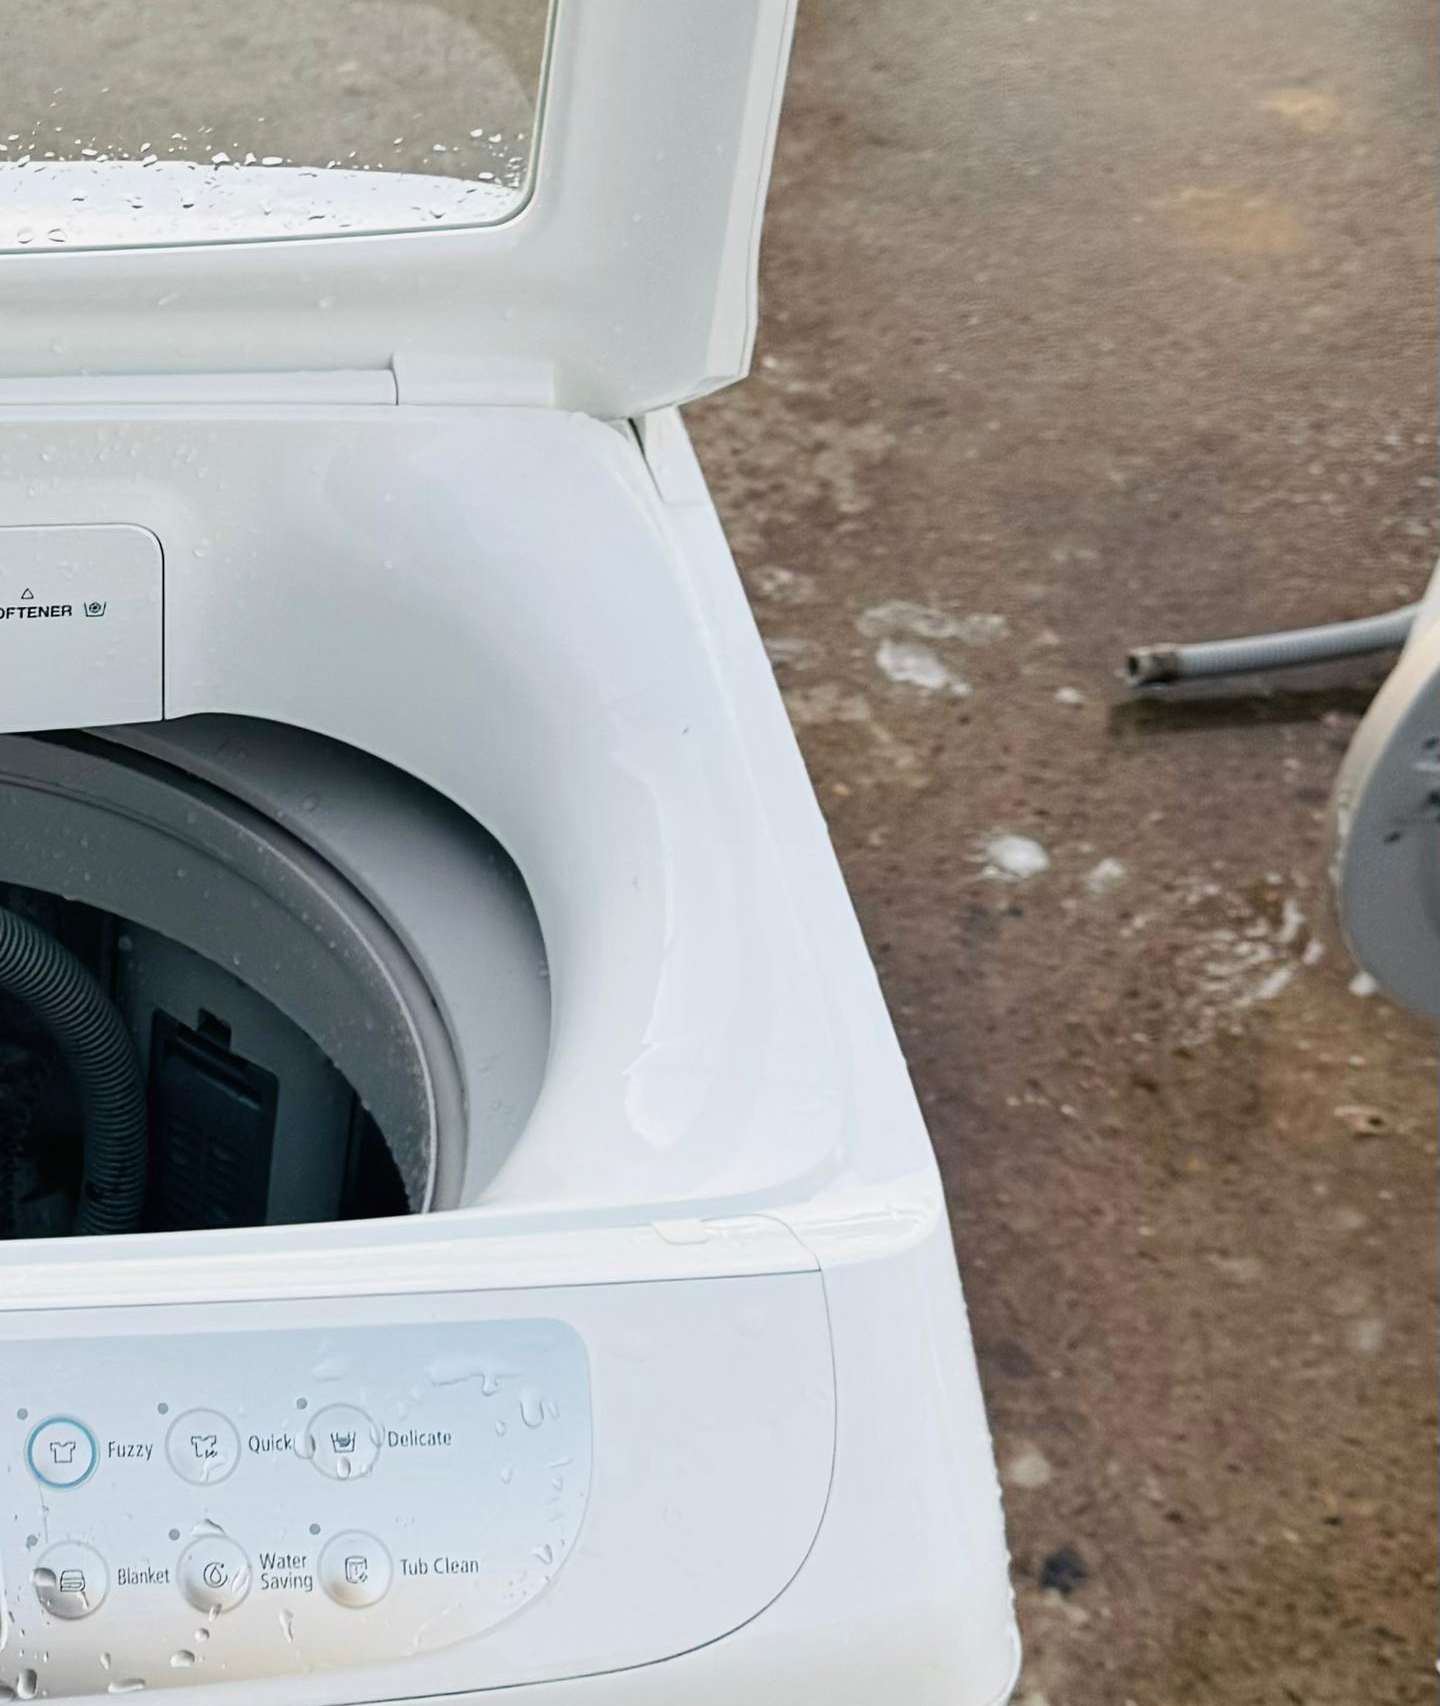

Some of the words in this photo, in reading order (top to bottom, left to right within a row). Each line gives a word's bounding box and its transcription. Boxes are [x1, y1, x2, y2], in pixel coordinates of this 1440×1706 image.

[248, 1434, 293, 1452] Quick
[387, 1429, 453, 1447] Delicate
[108, 1441, 154, 1461] Fuzzy
[260, 1553, 308, 1570] Water
[400, 1558, 428, 1575] Tub
[433, 1557, 480, 1574] Clean
[117, 1567, 170, 1585] Blanket
[261, 1573, 314, 1592] Saving
